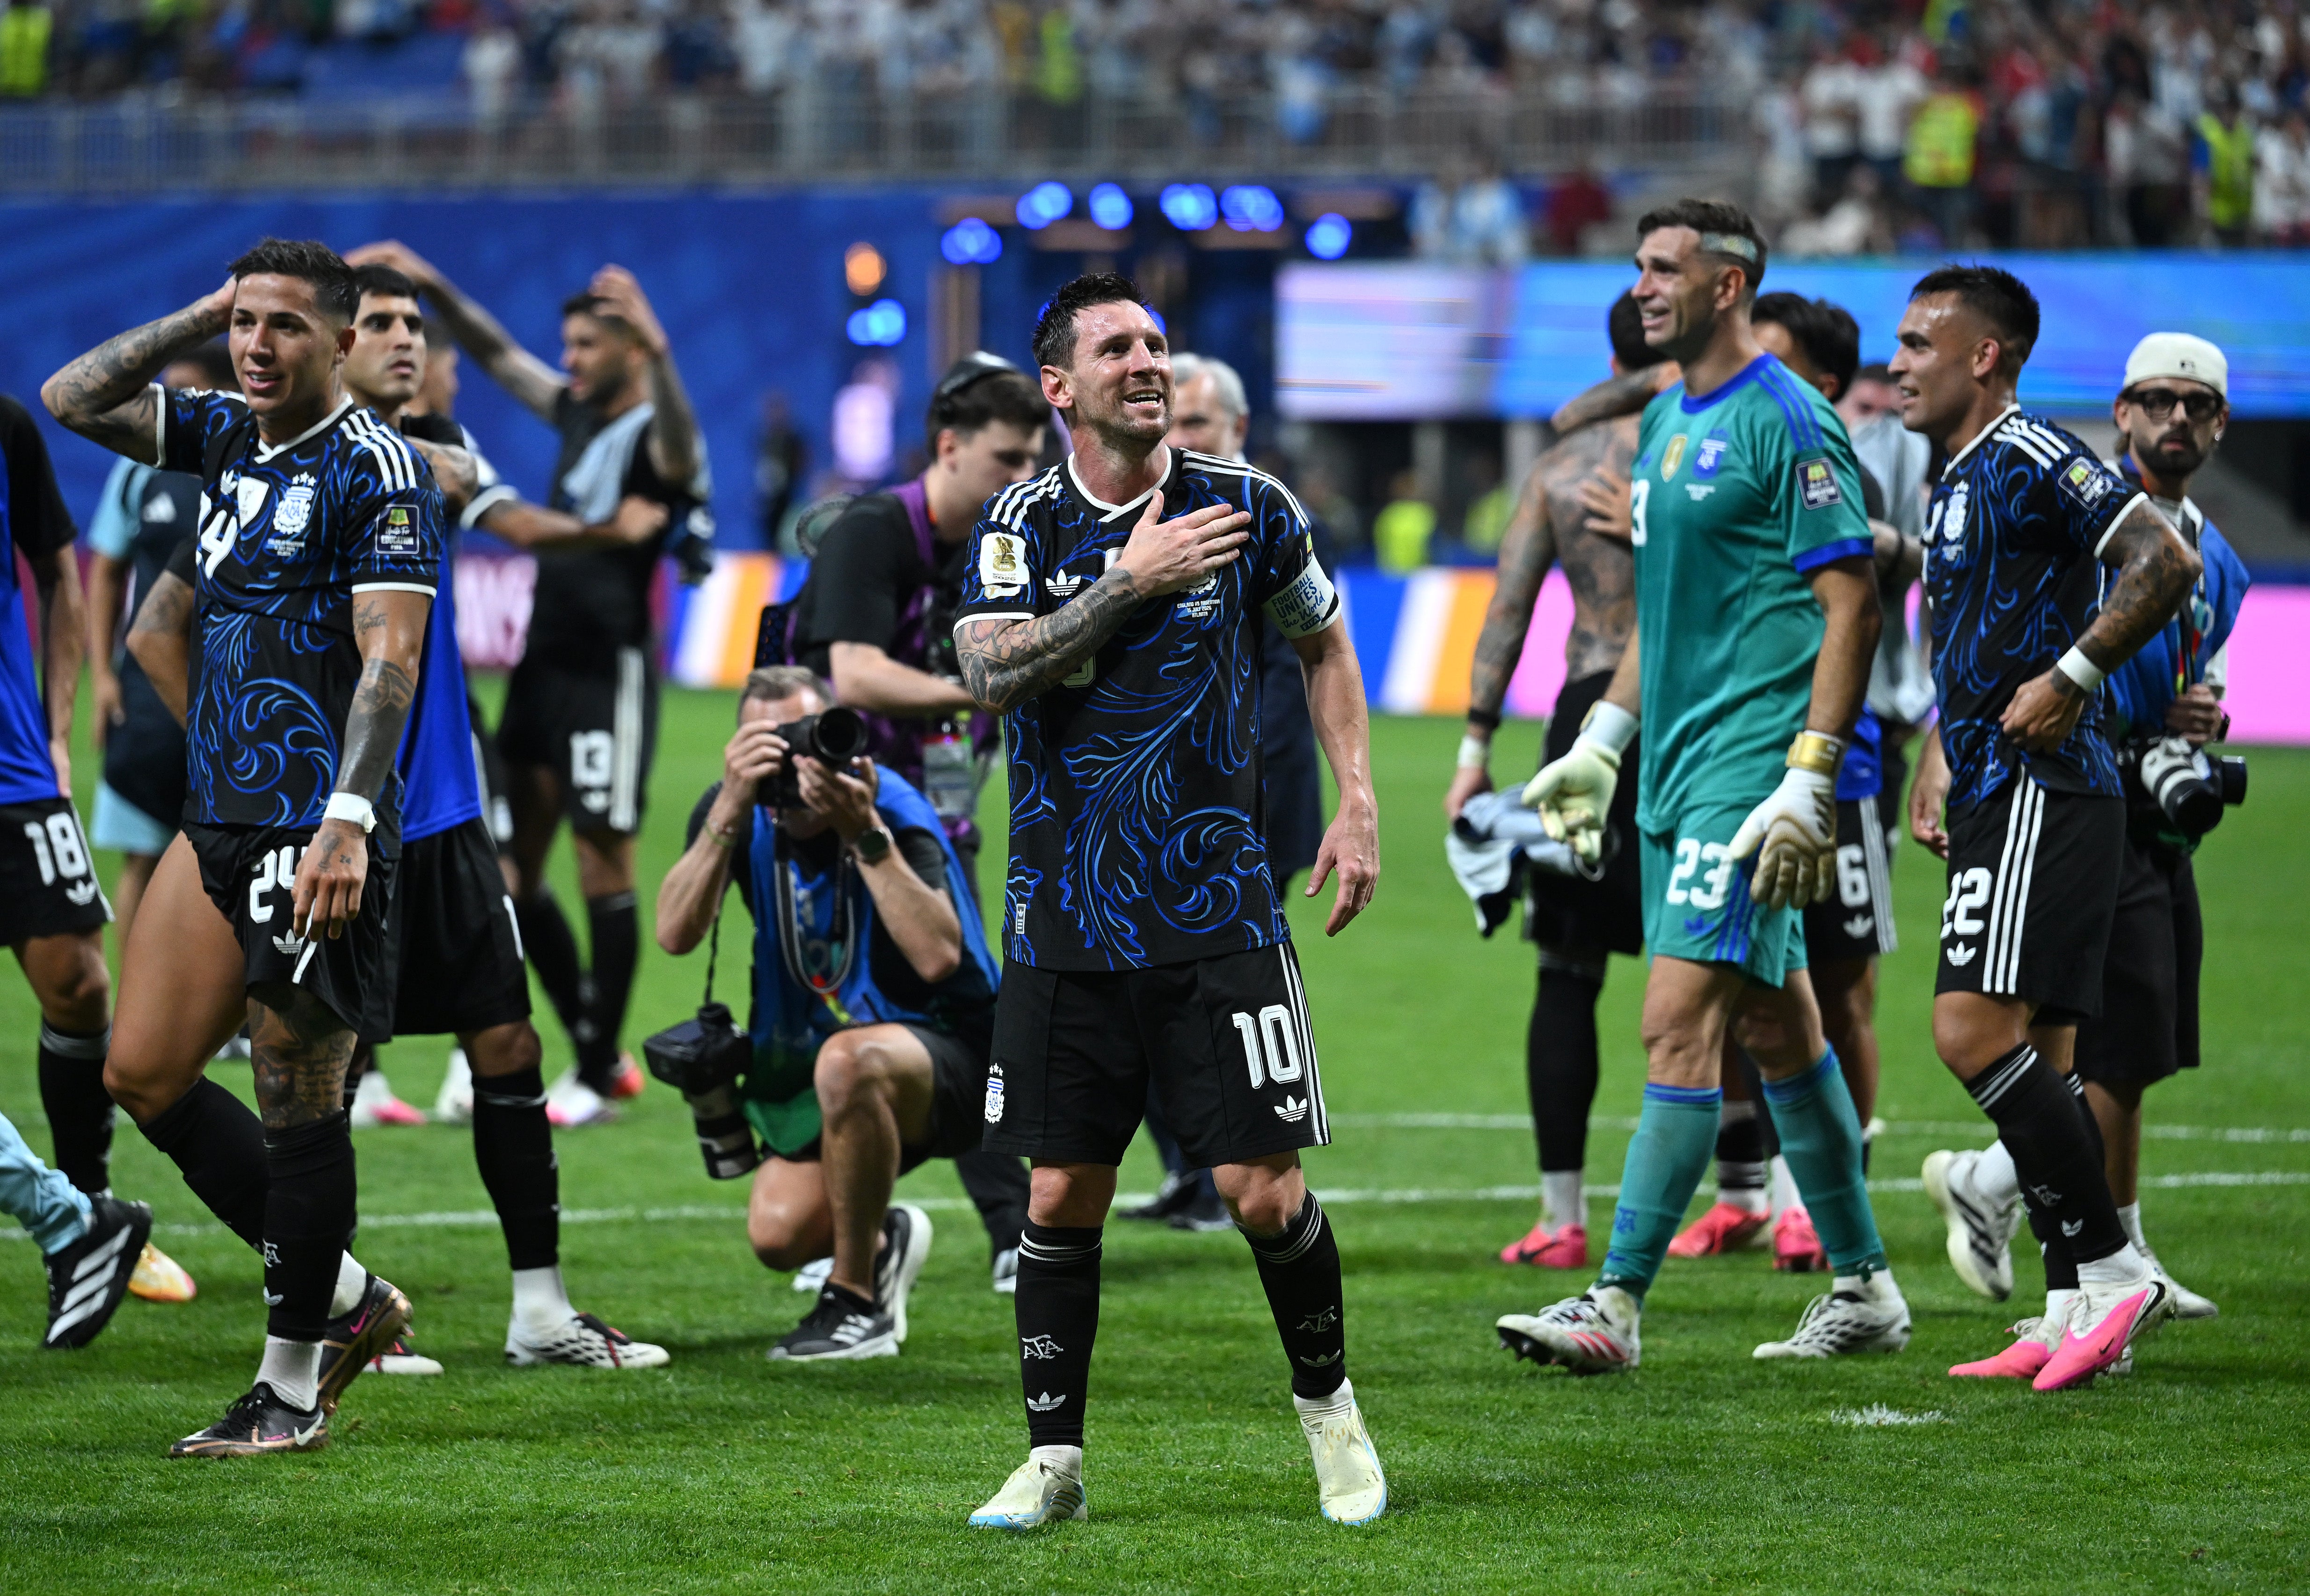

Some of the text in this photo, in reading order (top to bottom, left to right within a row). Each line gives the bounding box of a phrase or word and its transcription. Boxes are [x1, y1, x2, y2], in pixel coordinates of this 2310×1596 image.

[1272, 573, 1311, 607] FOOTBALL
[1273, 581, 1317, 619] UNITES
[1281, 590, 1326, 628] the World
[1303, 616, 1319, 631] FIFA
[23, 811, 89, 887] 18
[1666, 838, 1734, 911] 23
[1940, 867, 1993, 940] 22
[1232, 1004, 1302, 1089] 10
[1022, 1334, 1064, 1359] AFA
